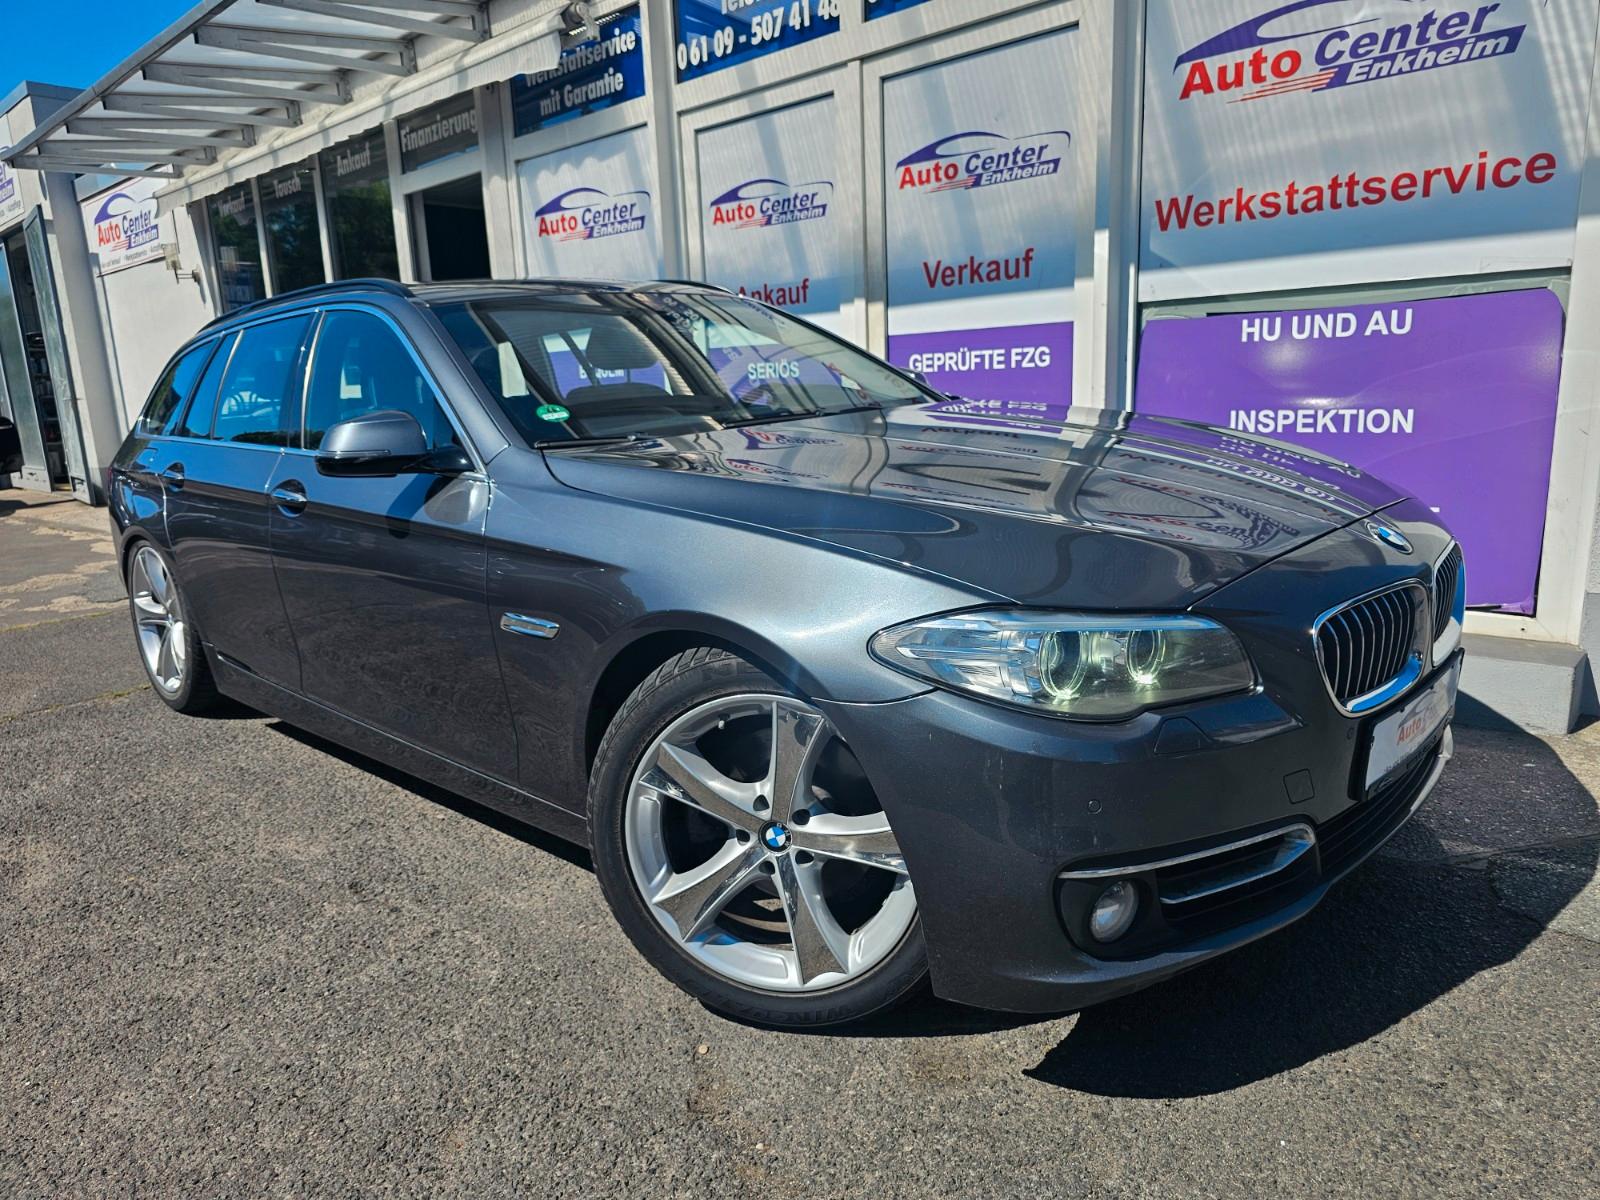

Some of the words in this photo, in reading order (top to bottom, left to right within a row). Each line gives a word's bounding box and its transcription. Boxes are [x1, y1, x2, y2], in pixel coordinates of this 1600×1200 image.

[751, 7, 784, 46] 507
[525, 27, 636, 87] Werkstattservice
[1179, 48, 1301, 100] Auto
[1314, 2, 1500, 67] Center
[1345, 31, 1509, 84] Enkheim
[540, 88, 561, 116] mit
[563, 67, 624, 107] Garantie
[400, 110, 478, 153] Finanzierung
[337, 141, 371, 177] Ankauf
[899, 161, 958, 189] Auto
[964, 144, 1048, 174] Center
[980, 161, 1054, 186] Enkheim
[712, 202, 755, 225] Auto
[759, 191, 818, 216] Center
[1154, 150, 1557, 232] Werkstattservice
[98, 221, 120, 247] Auto
[122, 210, 151, 235] Center
[538, 214, 577, 237] Auto
[581, 202, 636, 227] Center
[592, 219, 642, 238] Enkheim
[771, 206, 823, 225] Enkheim
[922, 248, 1034, 288] Verkauf
[1241, 317, 1281, 342] HU
[1291, 312, 1357, 339] UND
[1364, 308, 1413, 336] AU
[747, 358, 800, 380] SERIÖS
[909, 347, 1005, 373] GEPRÜFTE
[1010, 346, 1050, 369] FZG
[1229, 408, 1414, 433] INSPEKTION
